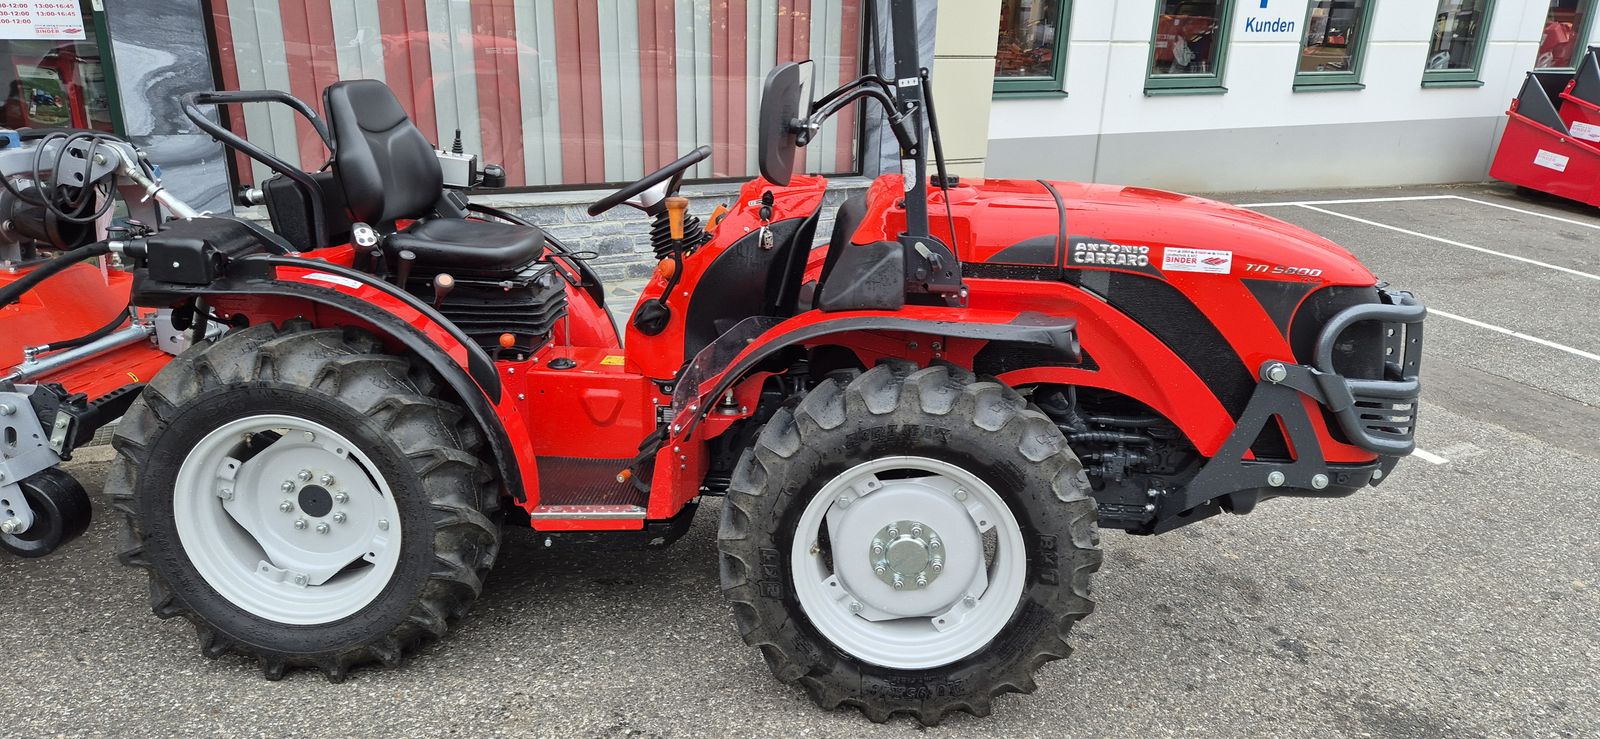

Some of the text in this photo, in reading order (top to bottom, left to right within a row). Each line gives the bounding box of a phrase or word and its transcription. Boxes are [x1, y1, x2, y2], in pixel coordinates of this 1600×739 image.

[1245, 17, 1295, 32] Kunden
[1075, 242, 1150, 254] ANTONIO
[1074, 251, 1149, 267] CARRARO
[1166, 256, 1198, 265] BINDER
